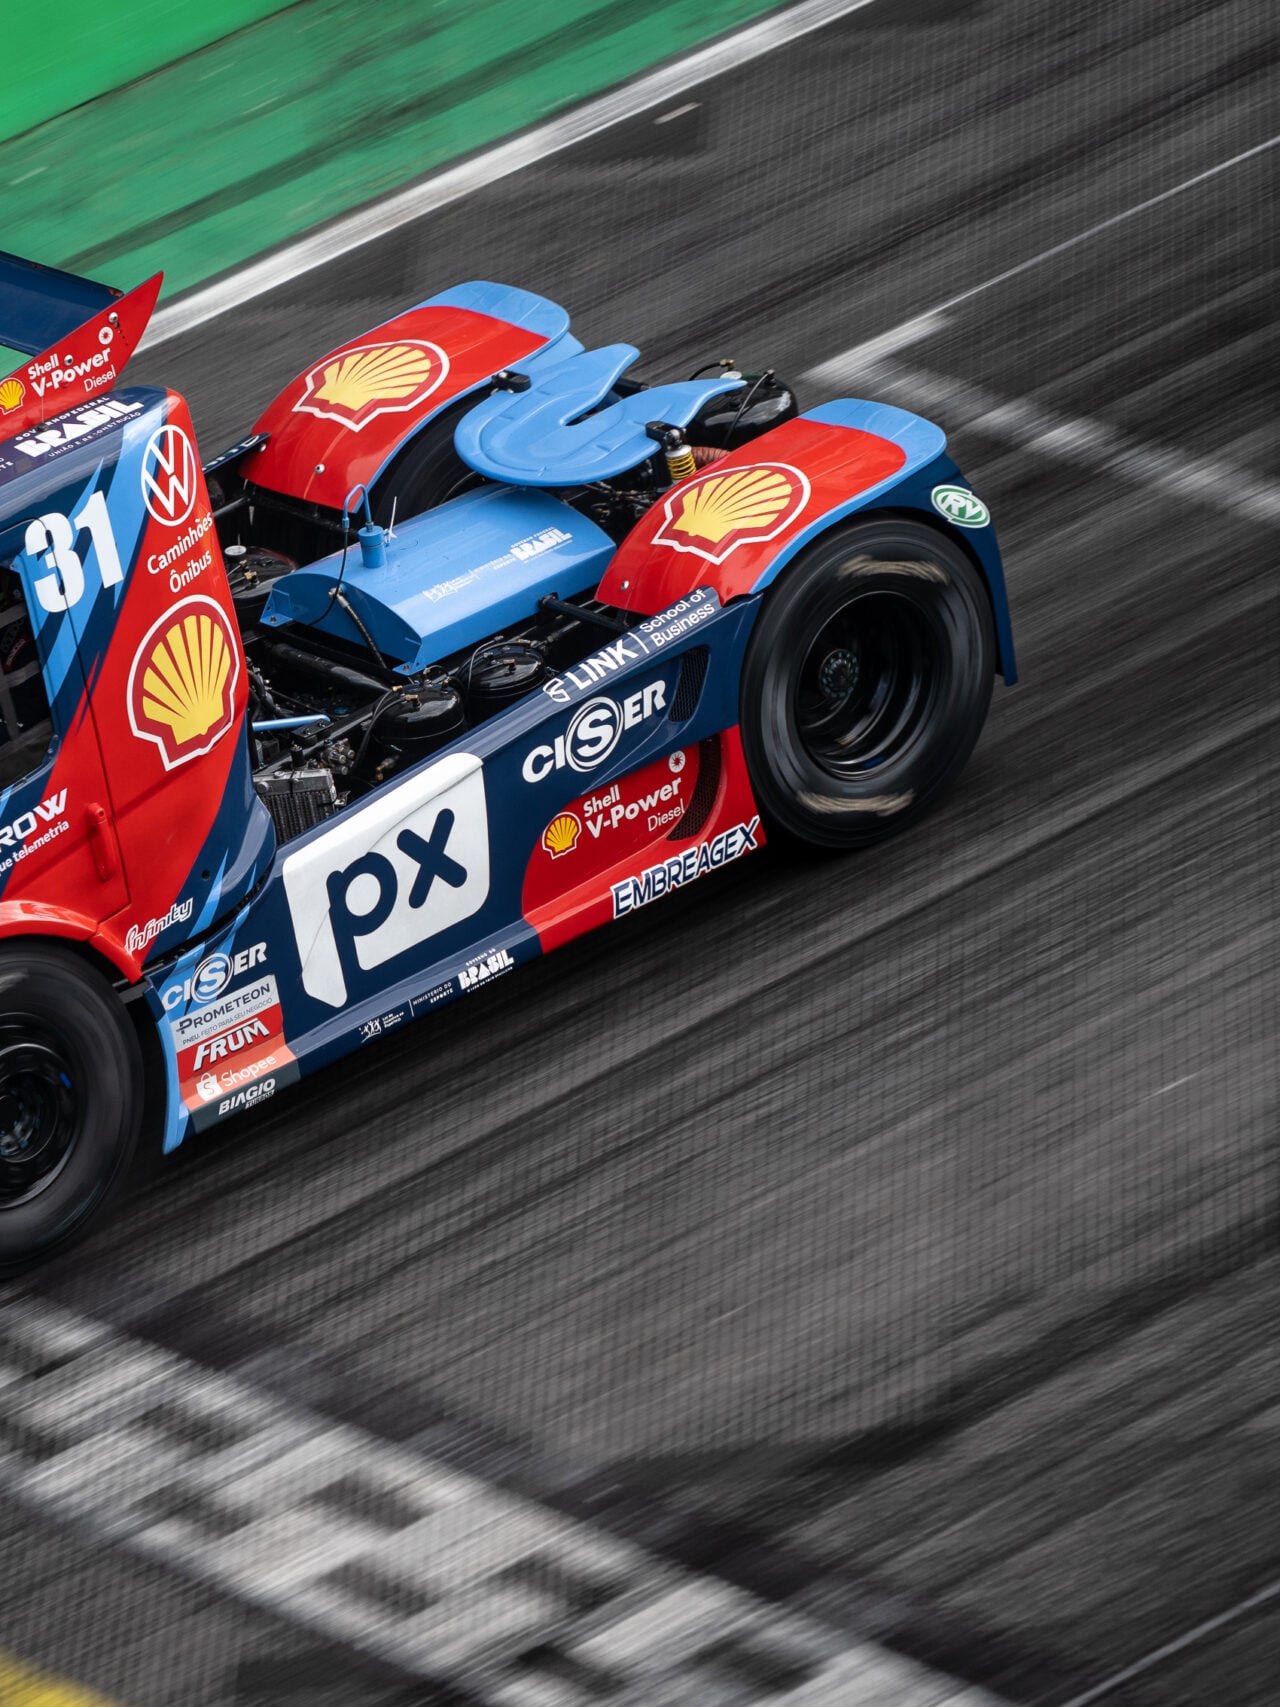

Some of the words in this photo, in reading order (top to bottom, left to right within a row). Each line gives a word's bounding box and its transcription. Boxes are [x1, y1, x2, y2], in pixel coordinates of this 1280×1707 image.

[27, 353, 59, 380] Shell
[31, 348, 111, 397] V-Power
[83, 364, 116, 393] Diesel
[14, 400, 144, 458] BRASIL
[25, 490, 124, 613] 31
[147, 511, 214, 575] Caminhões
[510, 528, 573, 561] BRASIL
[169, 549, 213, 593] Ônibus
[639, 597, 691, 634] School
[689, 589, 707, 603] of
[650, 603, 716, 648] Business
[564, 638, 639, 690] LINK
[522, 679, 666, 783] CISER
[583, 784, 621, 818] Shell
[585, 777, 682, 839] V-Power
[647, 798, 685, 832] Diesel
[12, 820, 70, 863] telemetria
[612, 815, 761, 919] EMBREAGEX
[123, 897, 194, 956] Infinity
[326, 811, 467, 1003] px
[162, 942, 267, 1012] CISER
[458, 949, 514, 990] BRASIL
[175, 983, 270, 1035] PROMETEON
[201, 1024, 218, 1037] FEITO
[218, 1016, 234, 1029] PARA
[234, 1010, 247, 1021] SEU
[193, 1019, 270, 1071] FRUM
[221, 1056, 277, 1087] Shopee
[219, 1078, 276, 1115] BIAGIO
